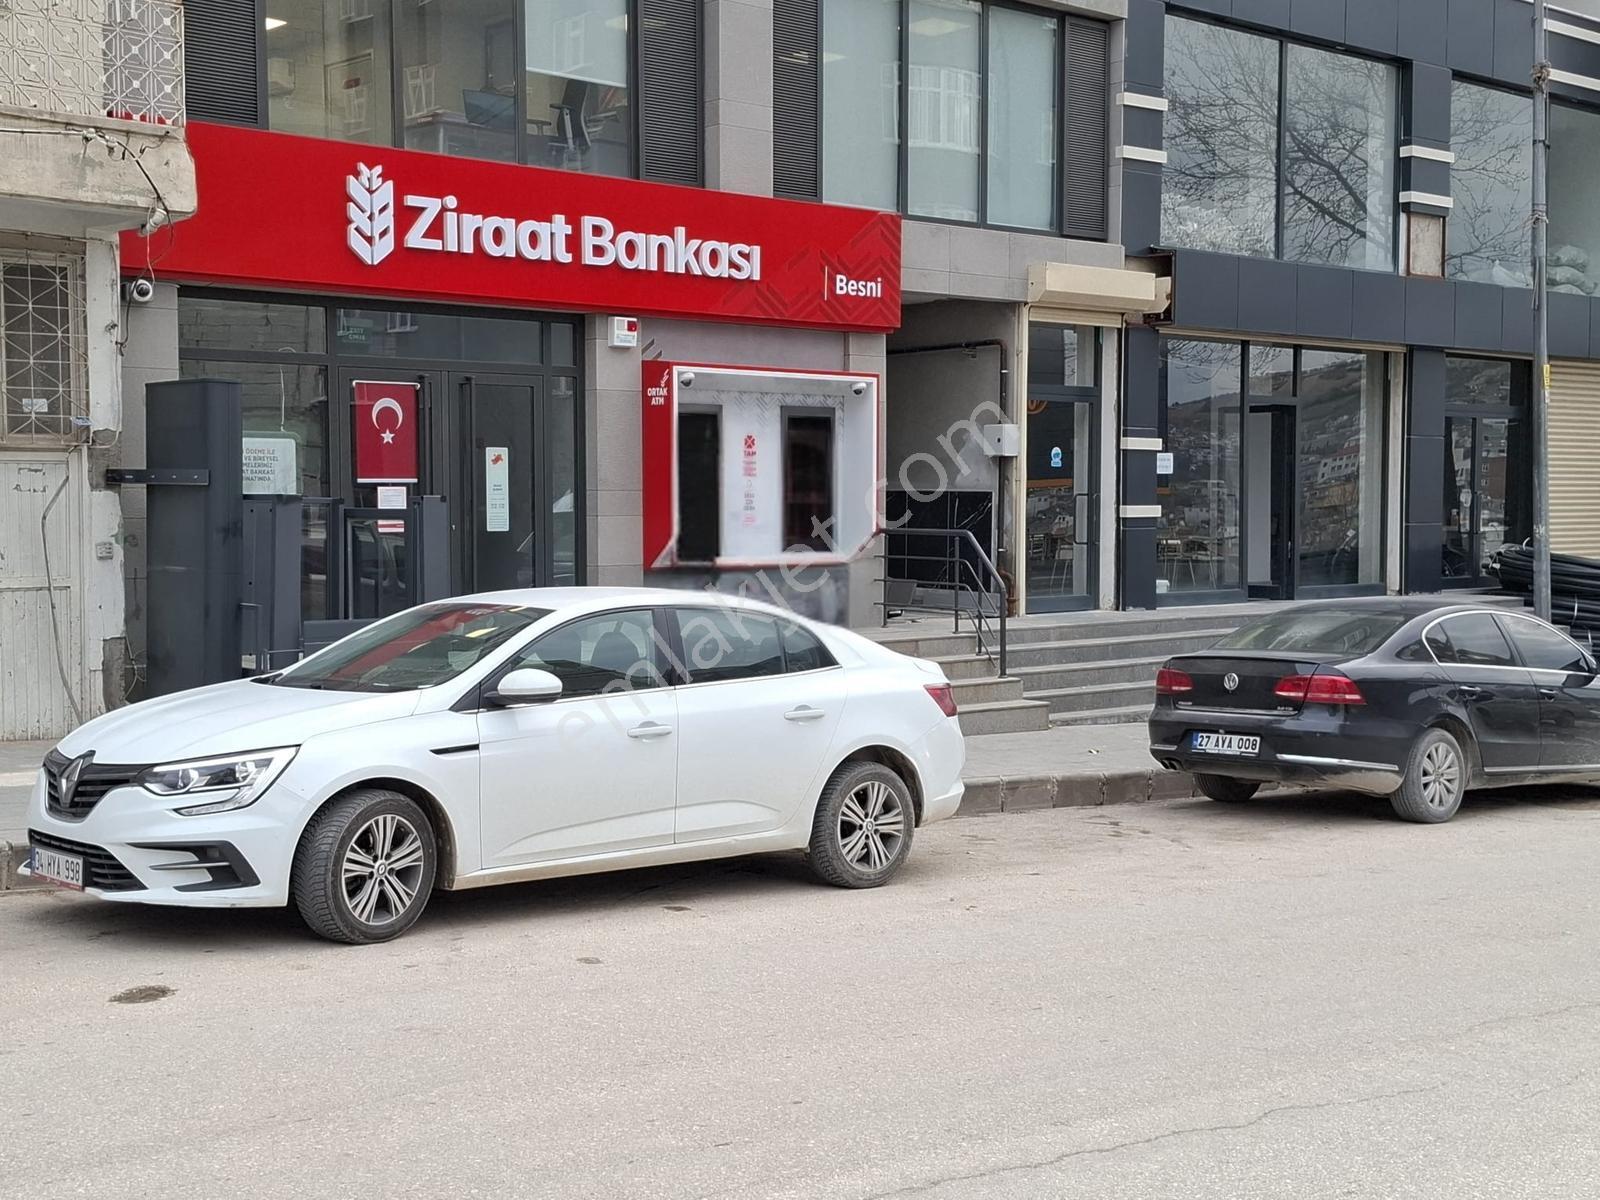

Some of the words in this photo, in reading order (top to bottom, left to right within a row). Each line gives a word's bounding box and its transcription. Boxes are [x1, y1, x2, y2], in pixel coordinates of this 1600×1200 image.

[404, 195, 572, 264] Ziraat
[581, 215, 761, 281] Bankası
[836, 274, 882, 298] Besni
[647, 387, 668, 397] ORTAK
[1198, 734, 1211, 748] 27
[1214, 735, 1233, 749] AYA
[1237, 737, 1258, 751] 008
[47, 853, 61, 876] HYA
[65, 860, 80, 882] 998
